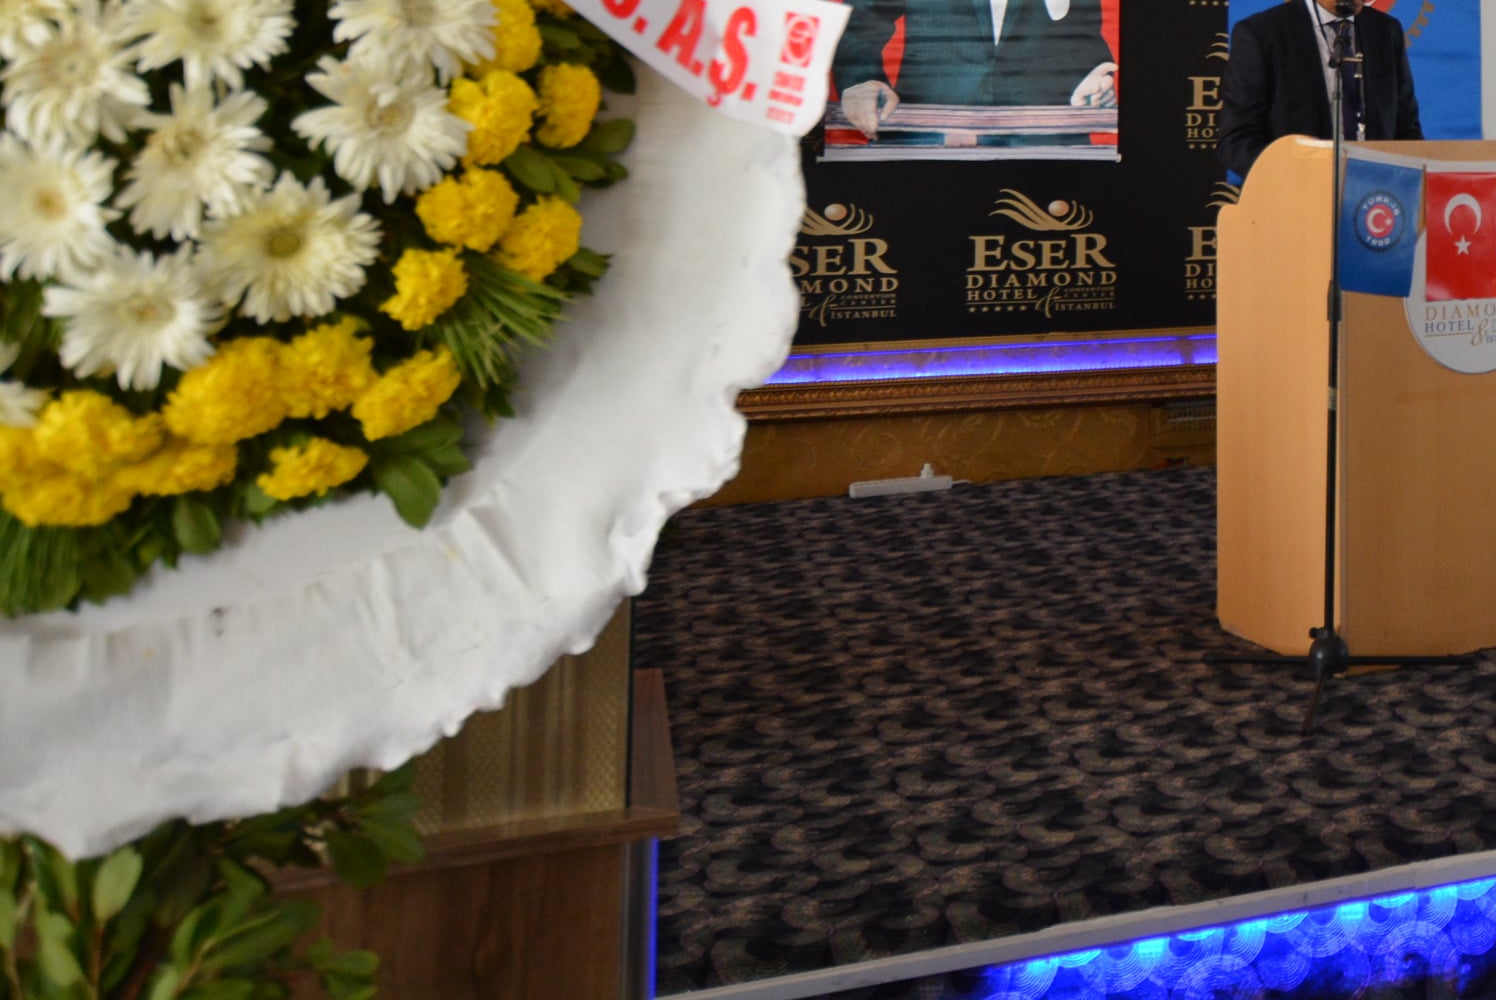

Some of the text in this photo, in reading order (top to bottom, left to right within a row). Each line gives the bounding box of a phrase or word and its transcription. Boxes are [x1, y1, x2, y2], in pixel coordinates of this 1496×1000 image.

[789, 238, 899, 277] SER
[966, 233, 1117, 271] ESER
[801, 277, 899, 293] MOND
[965, 271, 1117, 289] DIAMOND
[967, 289, 1038, 301] HOTEL
[1425, 320, 1475, 333] HOTEL
